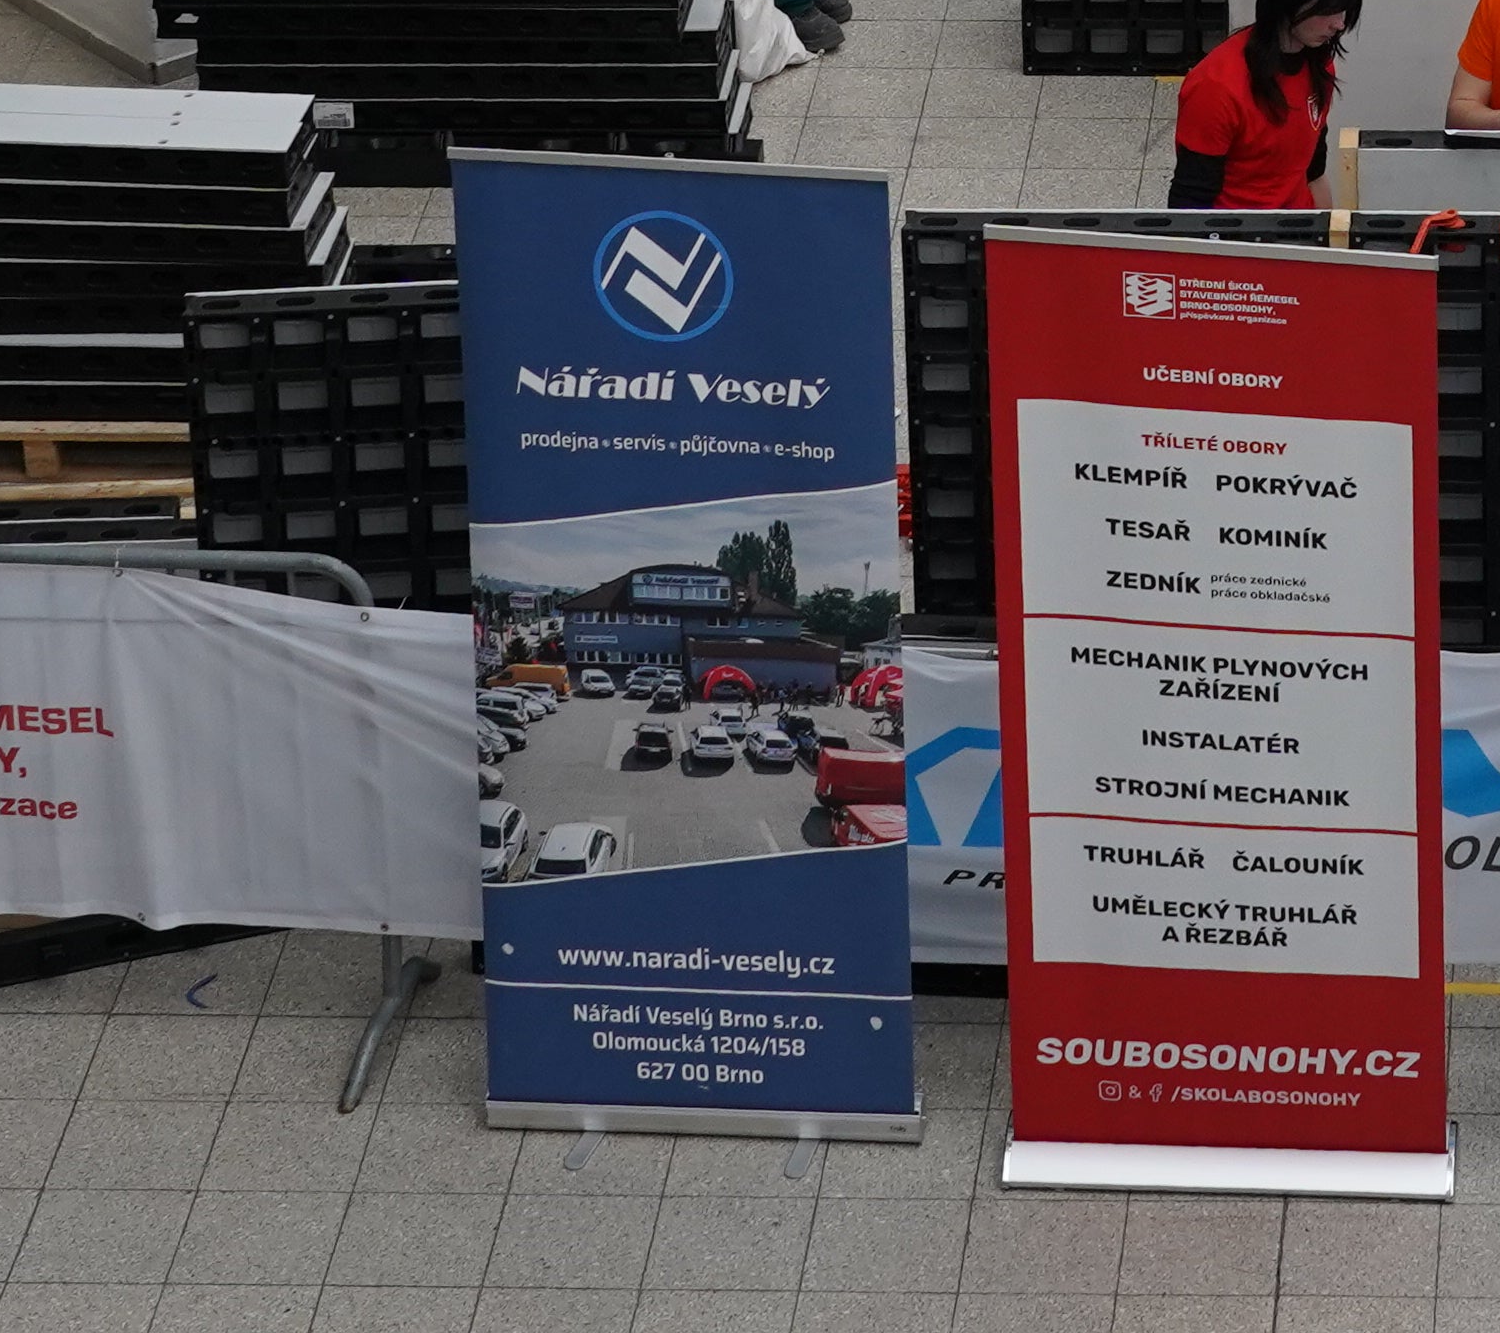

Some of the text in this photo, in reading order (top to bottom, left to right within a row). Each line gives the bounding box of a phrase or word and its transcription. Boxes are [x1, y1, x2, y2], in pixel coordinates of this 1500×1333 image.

[515, 365, 831, 410] Nářadí Veselý
[1142, 364, 1284, 390] UČEBNÍ OBORY
[520, 429, 836, 464] prodejna servis půjčovna e-shop
[1140, 431, 1288, 456] TŘÍLETÉ OBORY
[1074, 462, 1358, 500] KLEMPÍŘ POKRÝVAČ
[1104, 517, 1328, 551] TESAŘ KOMINÍK
[1105, 569, 1202, 595] ZEDNÍK
[1209, 572, 1308, 588] práce zednické
[1210, 587, 1248, 600] práce
[1070, 646, 1369, 682] MECHANIK PLYNOVÝCH
[1158, 676, 1282, 704] ZAŘÍZENÍ
[1141, 728, 1300, 755] INSTALATÉR
[1094, 775, 1350, 807] STROJNÍ MECHANIK
[1082, 844, 1365, 876] TRUHLÁŘ ČALOUNÍK
[1092, 893, 1358, 926] UMĚLECKÝ TRUHLÁŘ
[1161, 921, 1288, 948] A ŘEZBÁŘ
[557, 946, 836, 979] www.naradi-vesely.cz
[572, 1003, 825, 1031] Nářadí Veselý Brno s.r.o.
[592, 1030, 806, 1057] Olomoucká 1204/158
[1035, 1036, 1421, 1079] SOUBOSONOHY.CZ
[636, 1061, 765, 1085] 627 00 Brno
[1170, 1085, 1362, 1107] /SKOLABOSONOHY
